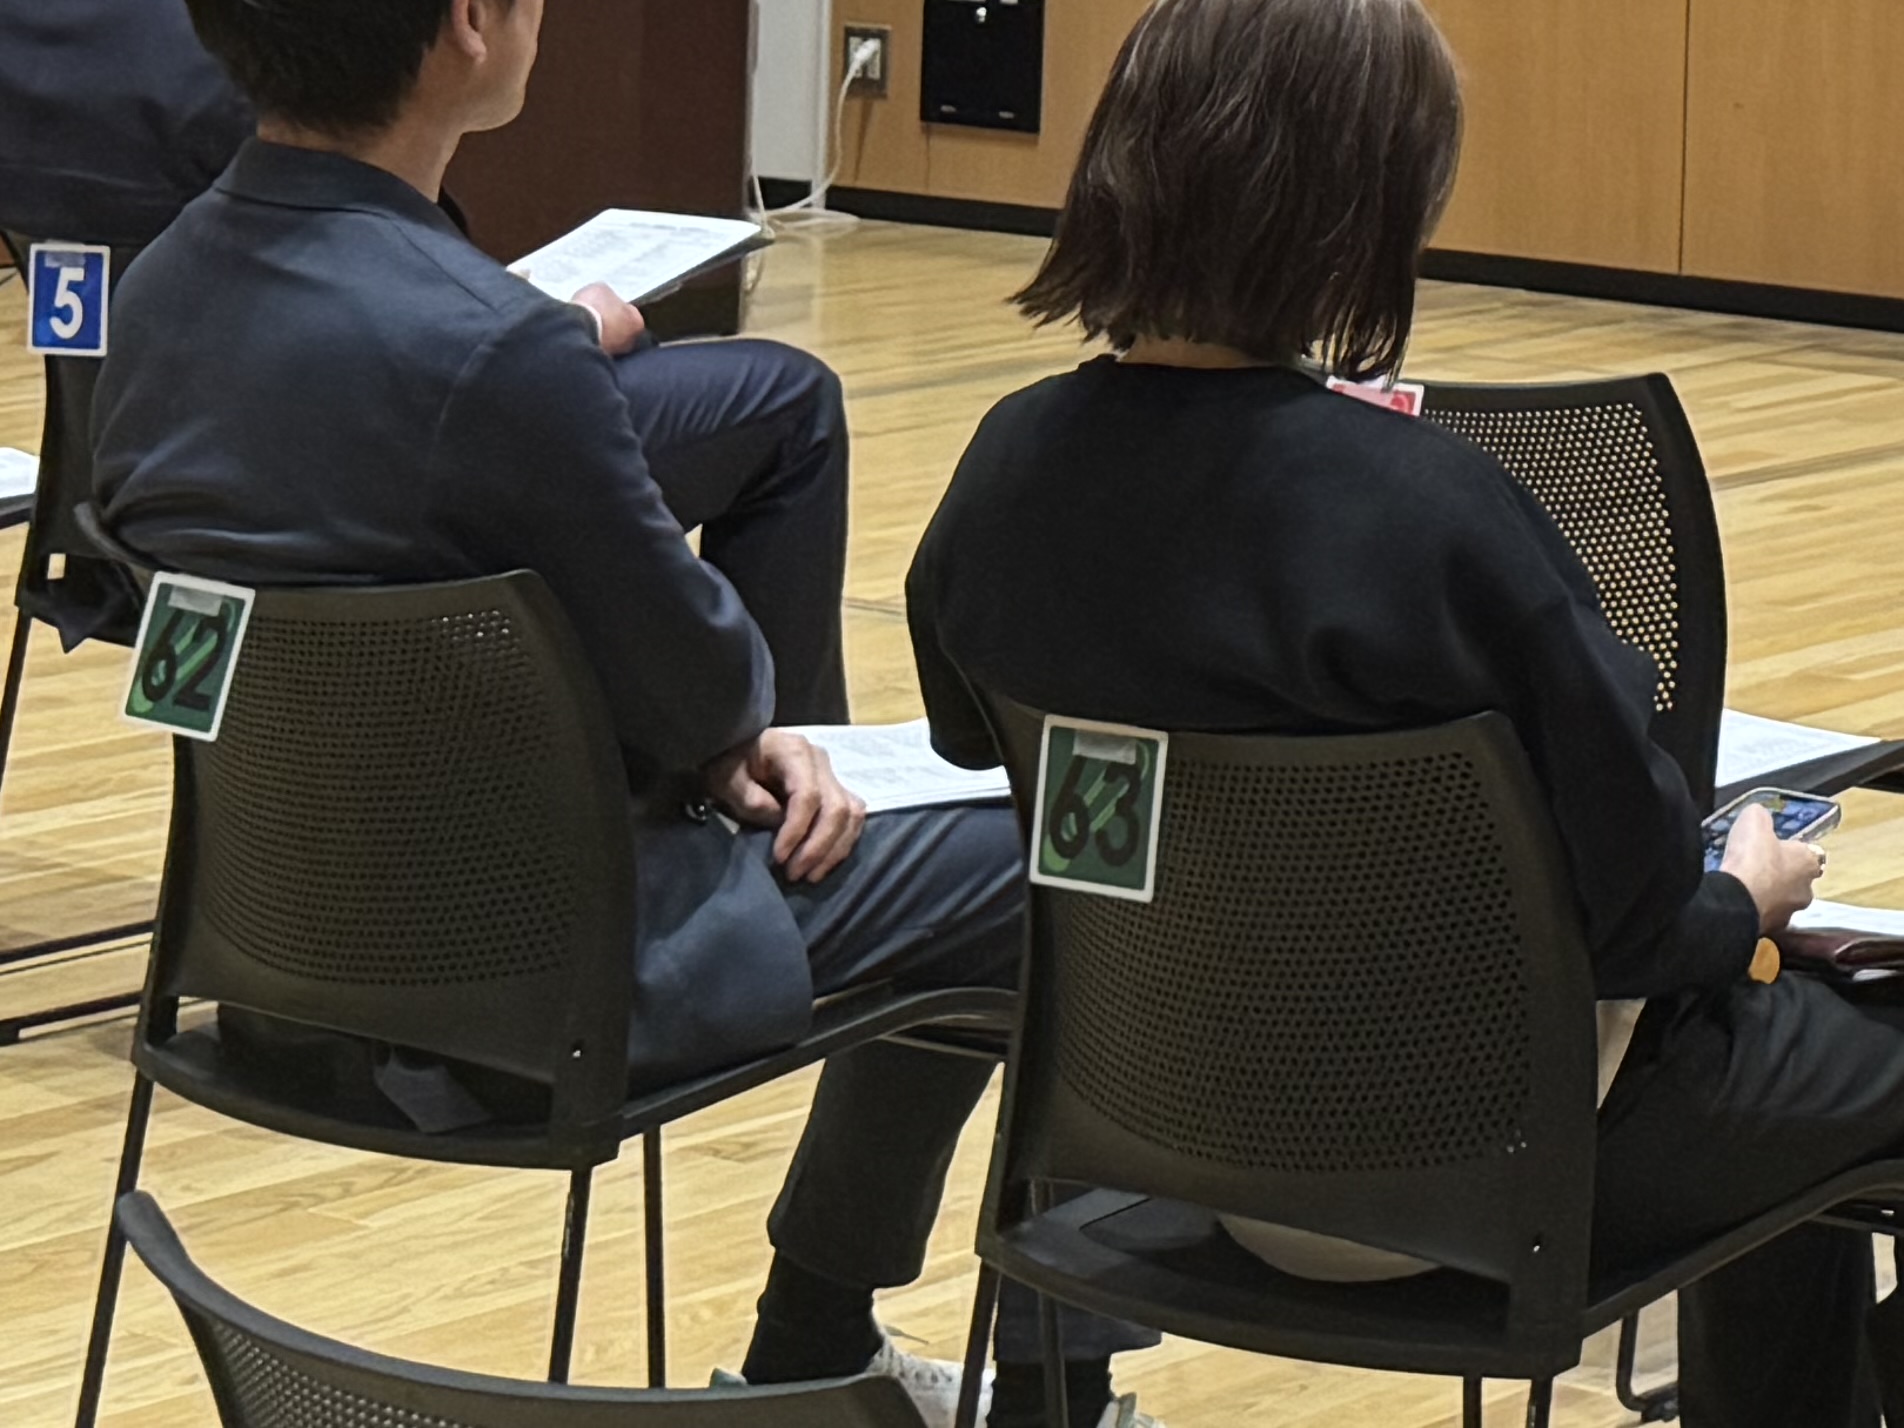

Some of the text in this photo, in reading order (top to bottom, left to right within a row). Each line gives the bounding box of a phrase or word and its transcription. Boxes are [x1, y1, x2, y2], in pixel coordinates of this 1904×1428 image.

[49, 266, 85, 340] 5
[141, 608, 229, 711] 62
[1048, 754, 1142, 868] 63
